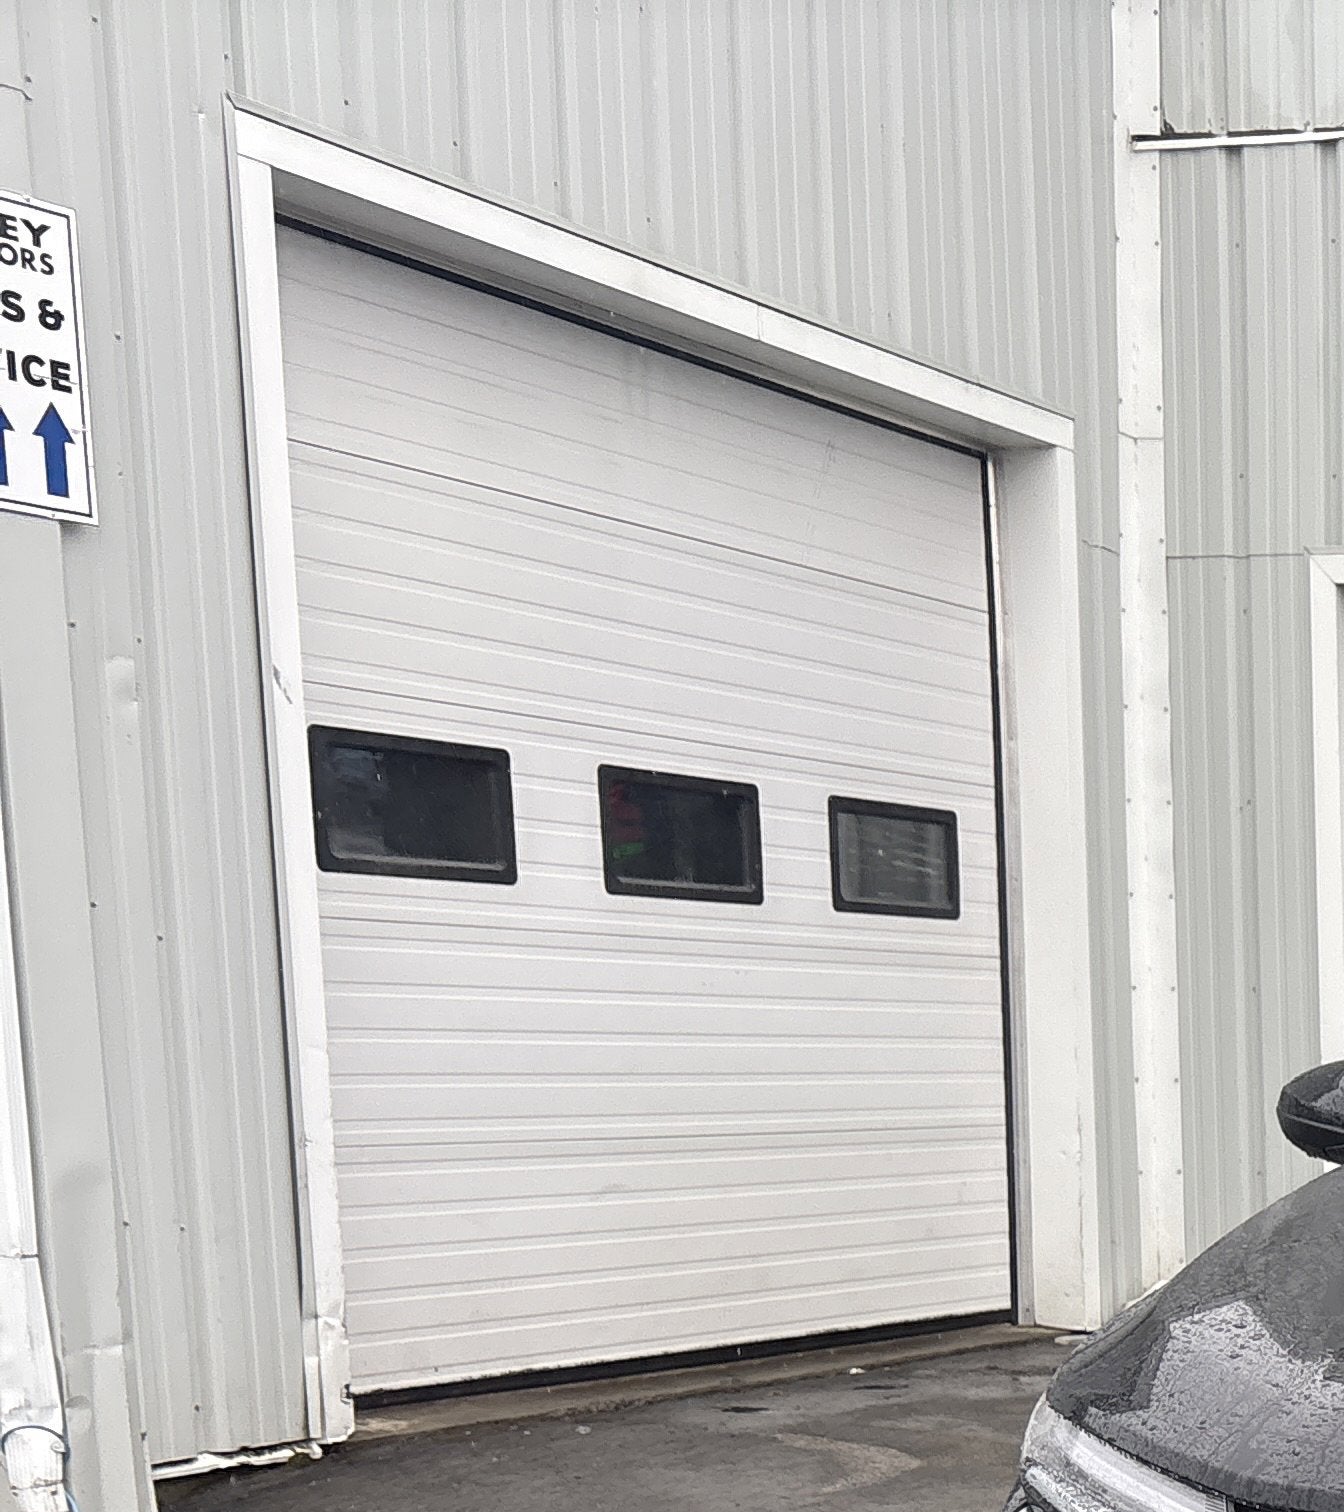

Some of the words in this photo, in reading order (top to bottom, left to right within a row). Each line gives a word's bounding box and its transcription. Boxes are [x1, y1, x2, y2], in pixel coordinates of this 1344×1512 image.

[0, 242, 54, 275] ORS
[38, 299, 65, 331] &
[0, 347, 72, 394] ICE
